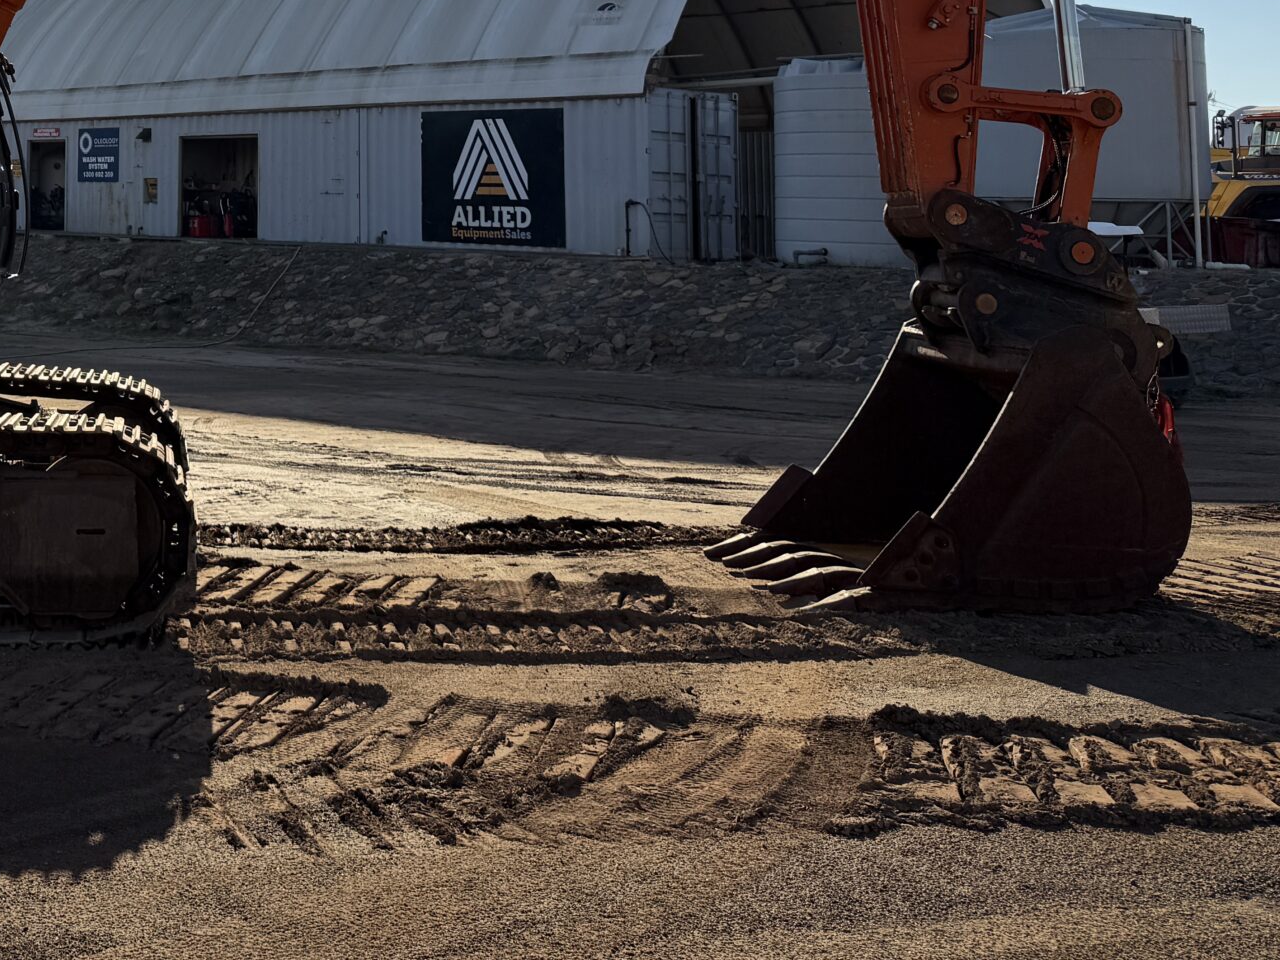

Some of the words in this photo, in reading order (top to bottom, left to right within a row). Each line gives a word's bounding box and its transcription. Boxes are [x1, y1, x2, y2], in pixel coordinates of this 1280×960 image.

[451, 205, 532, 228] ALLIED
[451, 227, 505, 240] Equipment
[505, 229, 532, 240] Sales
